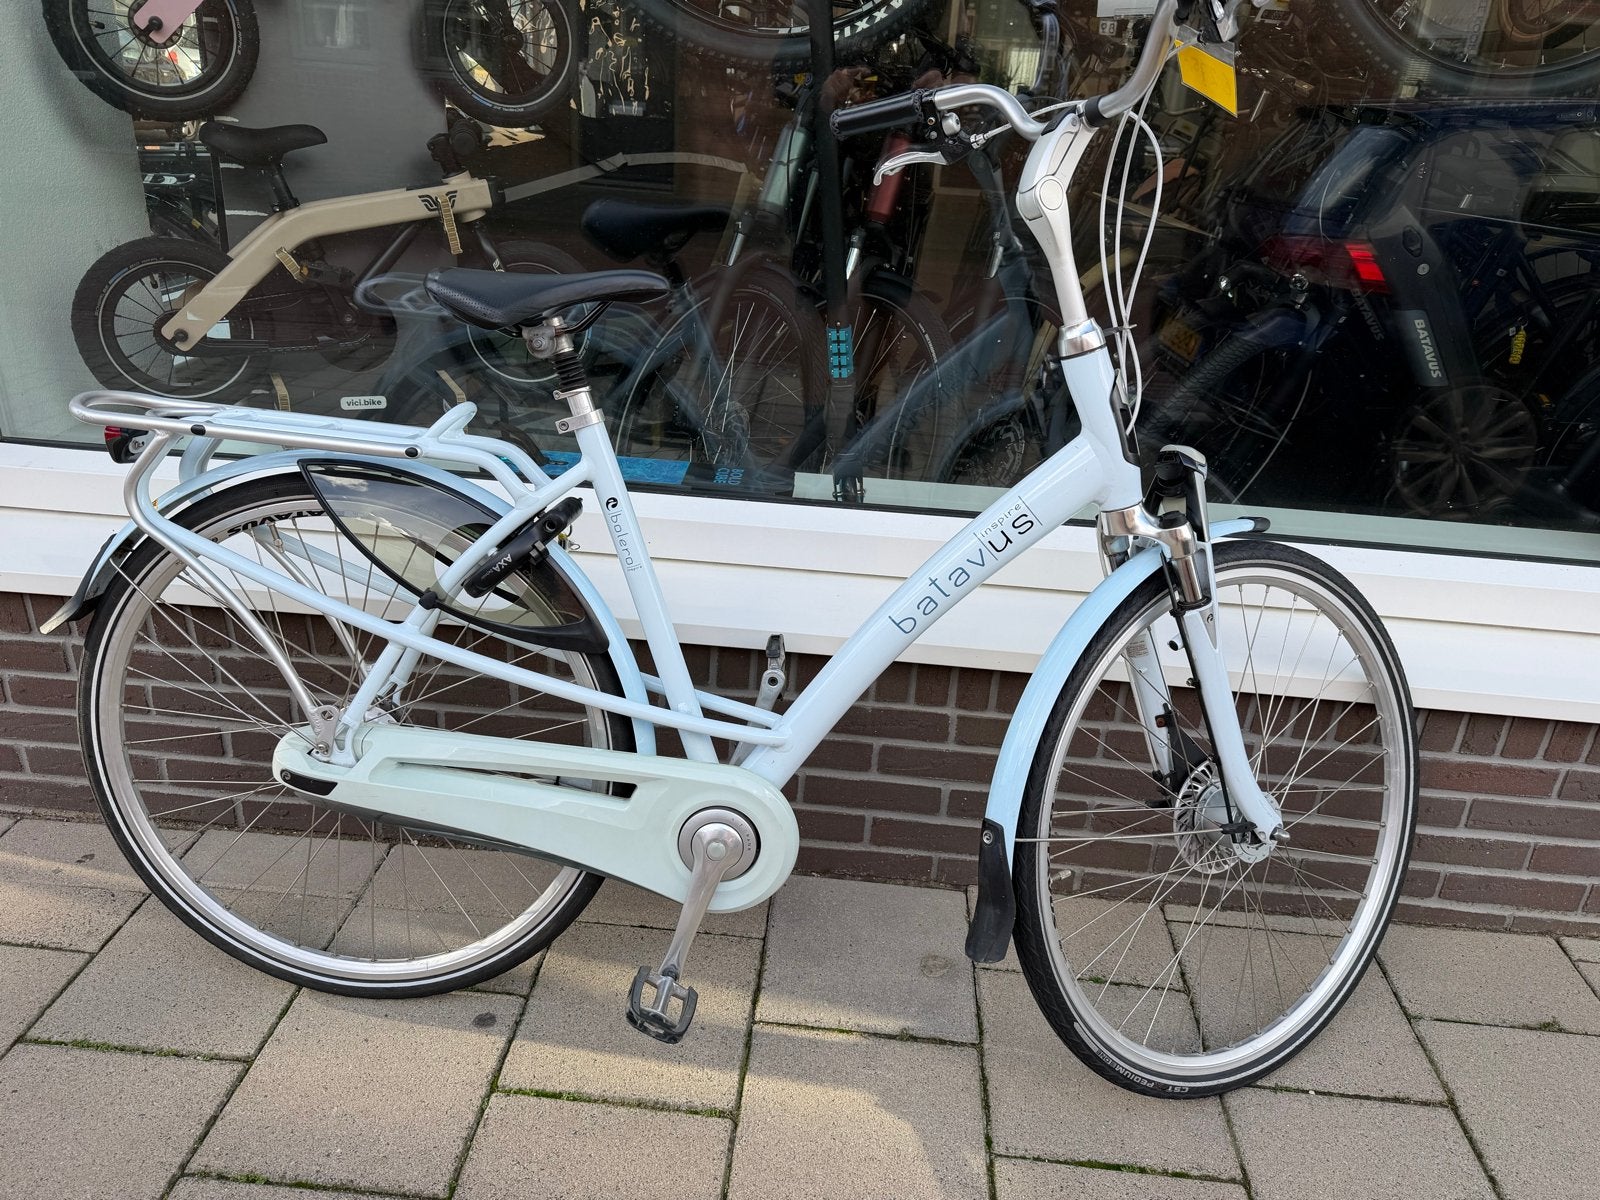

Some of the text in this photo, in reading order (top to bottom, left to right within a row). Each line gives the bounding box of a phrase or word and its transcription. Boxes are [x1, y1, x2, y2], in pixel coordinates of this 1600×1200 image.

[1414, 319, 1442, 378] BATAVUS
[346, 399, 382, 407] vici.bike
[978, 502, 1022, 538] inspire
[610, 513, 634, 566] bolero
[492, 553, 512, 572] AXA
[1168, 1085, 1189, 1093] CST
